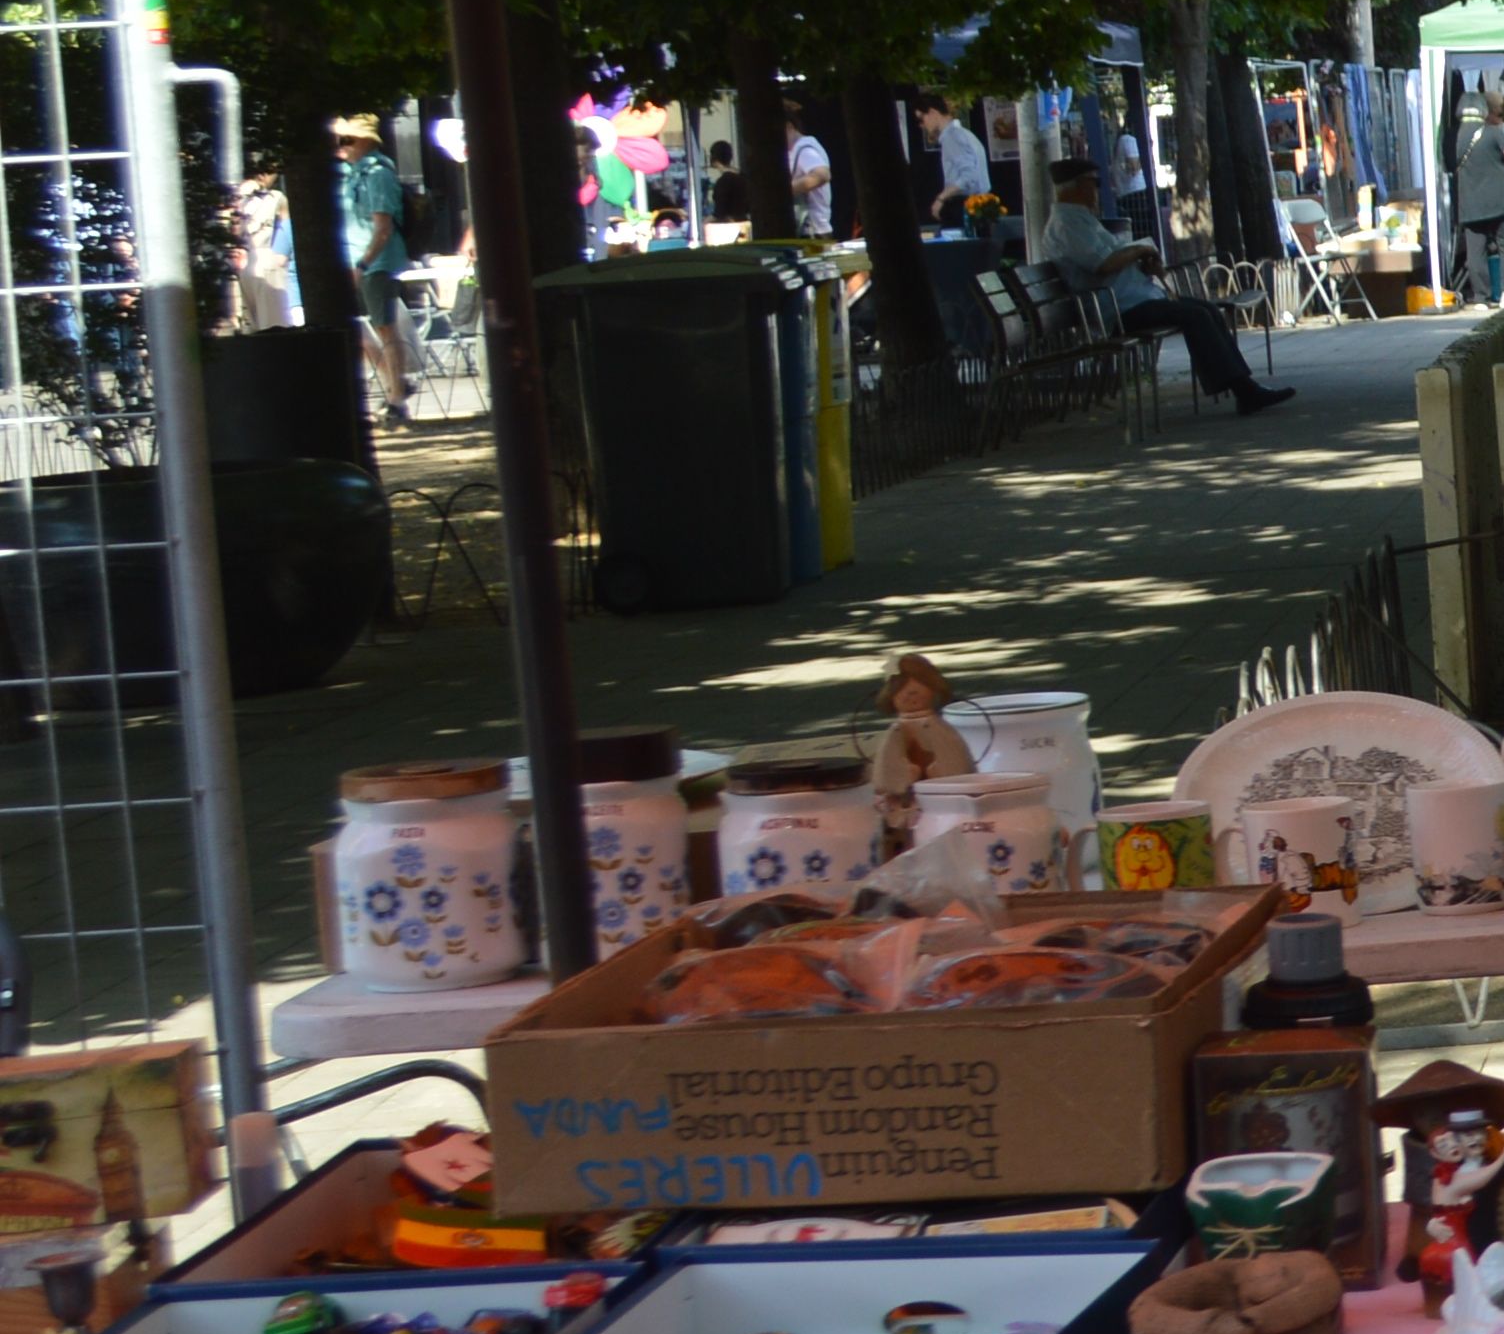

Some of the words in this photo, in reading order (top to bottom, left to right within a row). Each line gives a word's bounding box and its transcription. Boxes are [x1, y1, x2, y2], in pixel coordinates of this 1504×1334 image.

[666, 1066, 859, 1109] Editorial
[865, 1055, 999, 1097] Grupo
[676, 1112, 810, 1148] House
[819, 1103, 999, 1140] Random
[576, 1153, 822, 1209] ULLERES
[819, 1139, 1002, 1183] Penguin
